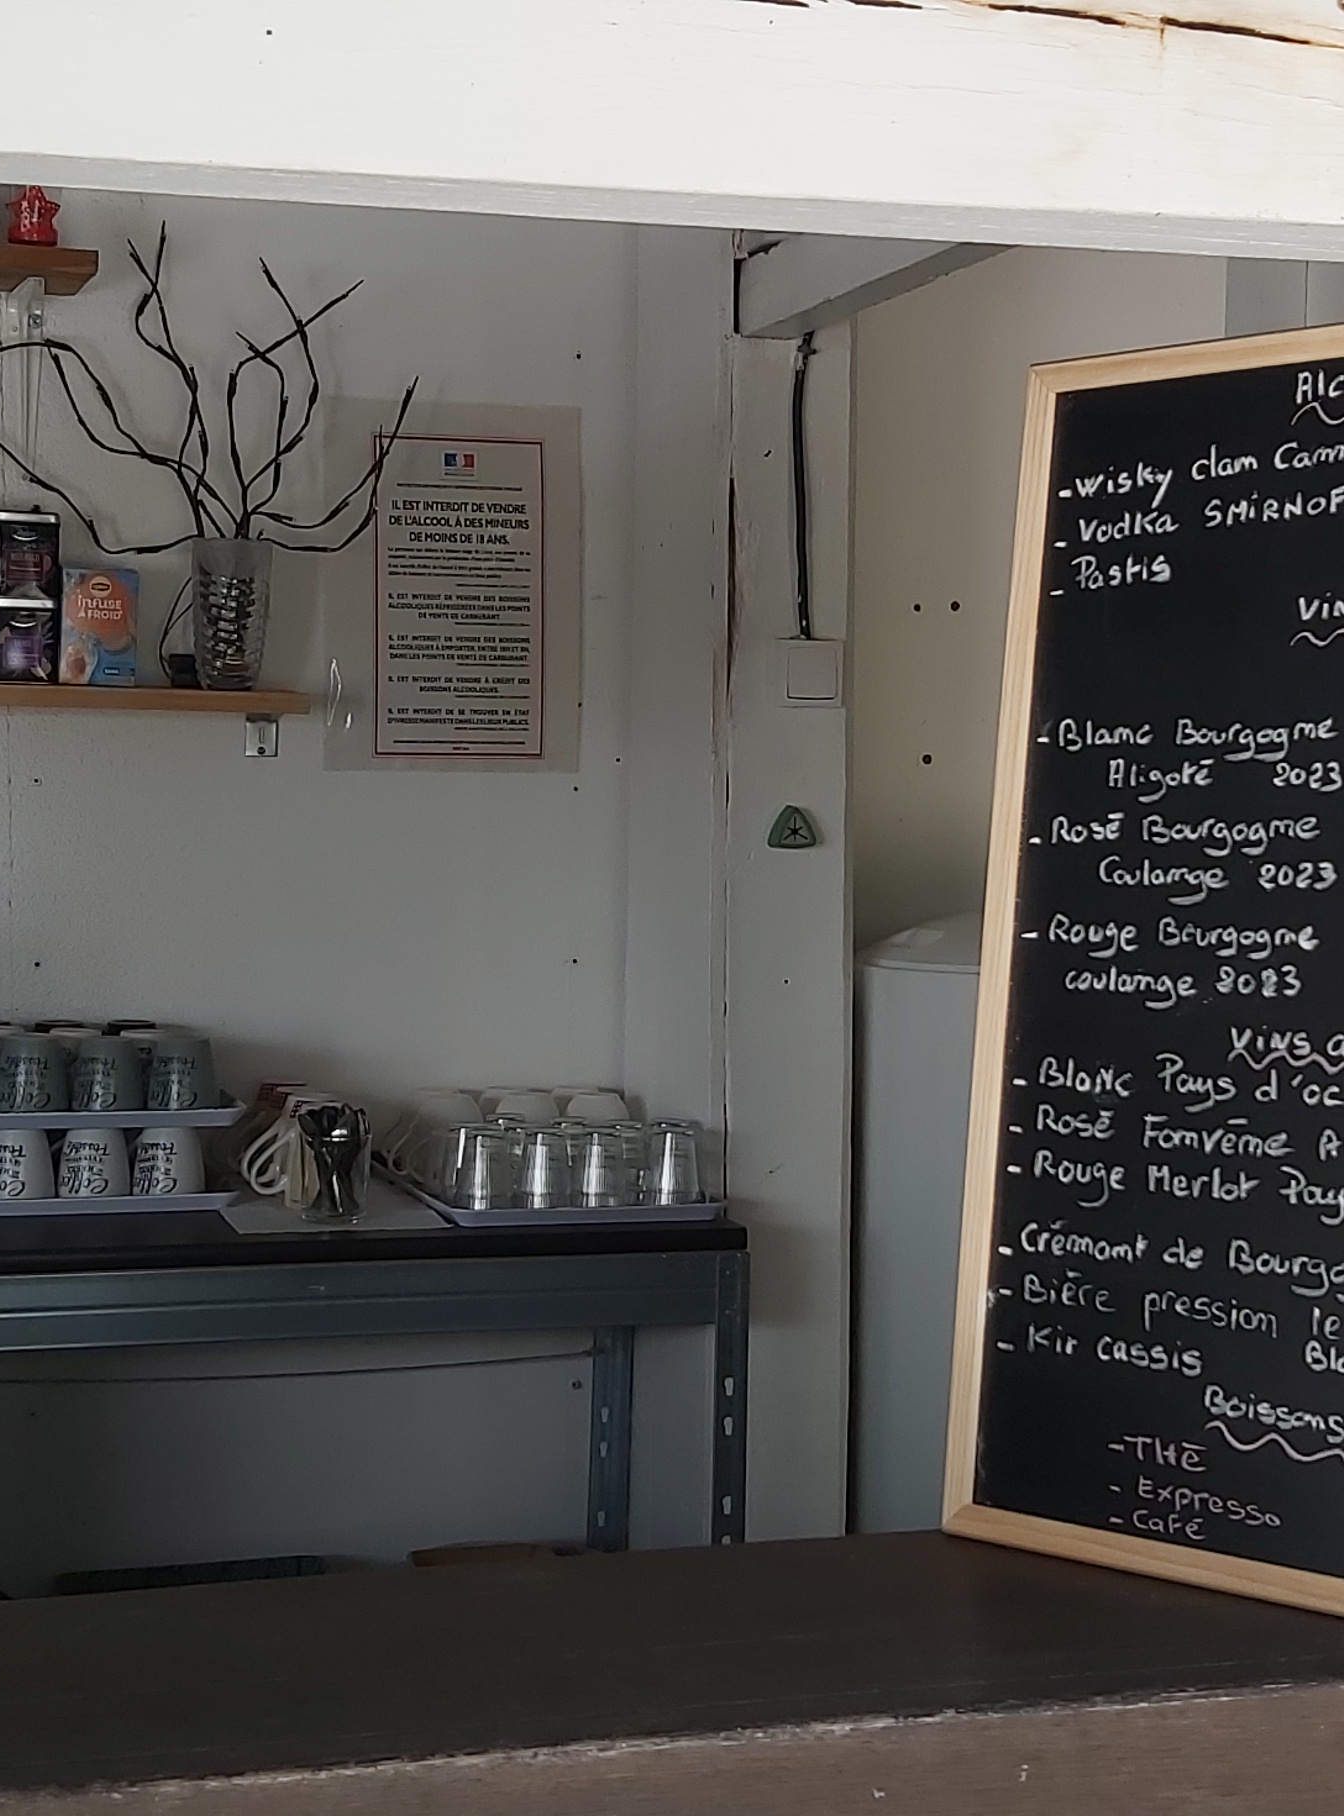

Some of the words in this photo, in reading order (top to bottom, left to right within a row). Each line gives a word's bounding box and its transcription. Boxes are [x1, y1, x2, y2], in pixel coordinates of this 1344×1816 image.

[389, 516, 403, 525] DE
[405, 516, 452, 527] L'ALCOOL
[455, 514, 462, 527] À
[464, 518, 483, 527] DES
[485, 519, 529, 529] MINEURS
[392, 500, 400, 510] IL
[403, 500, 421, 510] EST
[423, 500, 468, 512] INTERDIT
[472, 503, 484, 512] DE
[487, 503, 526, 514] VENDRE
[409, 532, 422, 542] DE
[425, 533, 458, 543] MOINS
[460, 534, 472, 543] DE
[1071, 555, 1170, 589] Pastis
[1273, 762, 1342, 791] 2023
[1259, 862, 1337, 889] 2023
[1049, 914, 1138, 957] Rouge
[1216, 965, 1301, 997] 2023
[1156, 1053, 1235, 1112] Pays
[1034, 1150, 1124, 1206] Rouge
[1149, 1166, 1259, 1200] Merlot
[1163, 1238, 1203, 1268] de
[1030, 1326, 1077, 1354] Kir
